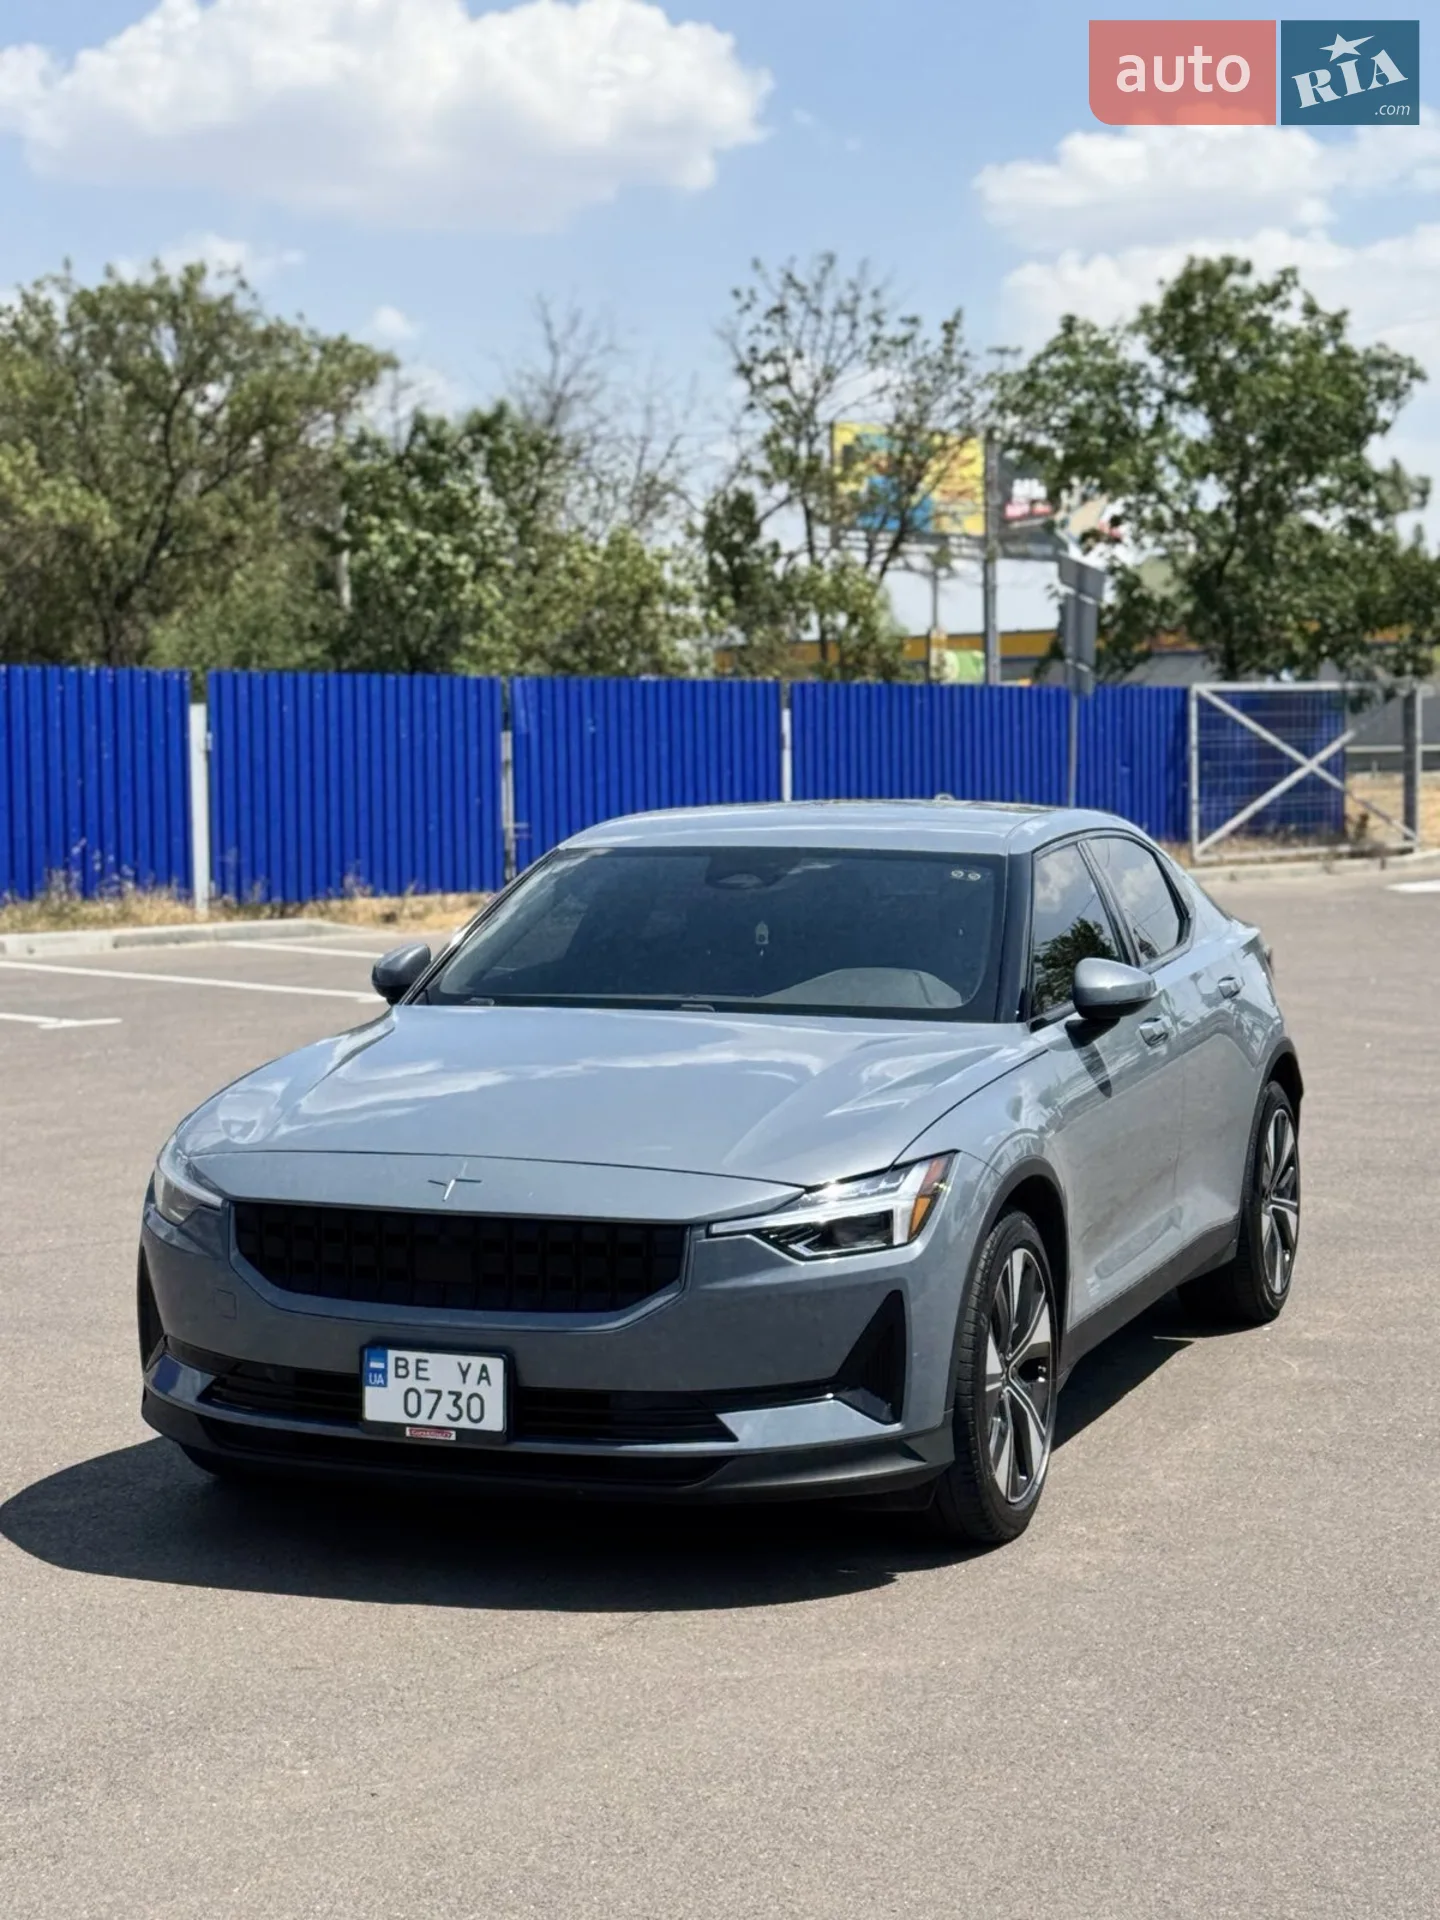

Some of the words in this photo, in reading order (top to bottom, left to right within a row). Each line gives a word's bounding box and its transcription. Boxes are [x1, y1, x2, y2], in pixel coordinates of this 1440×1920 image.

[368, 1373, 385, 1385] UA
[394, 1356, 431, 1381] BE
[457, 1361, 492, 1387] YA
[403, 1387, 485, 1424] 0730
